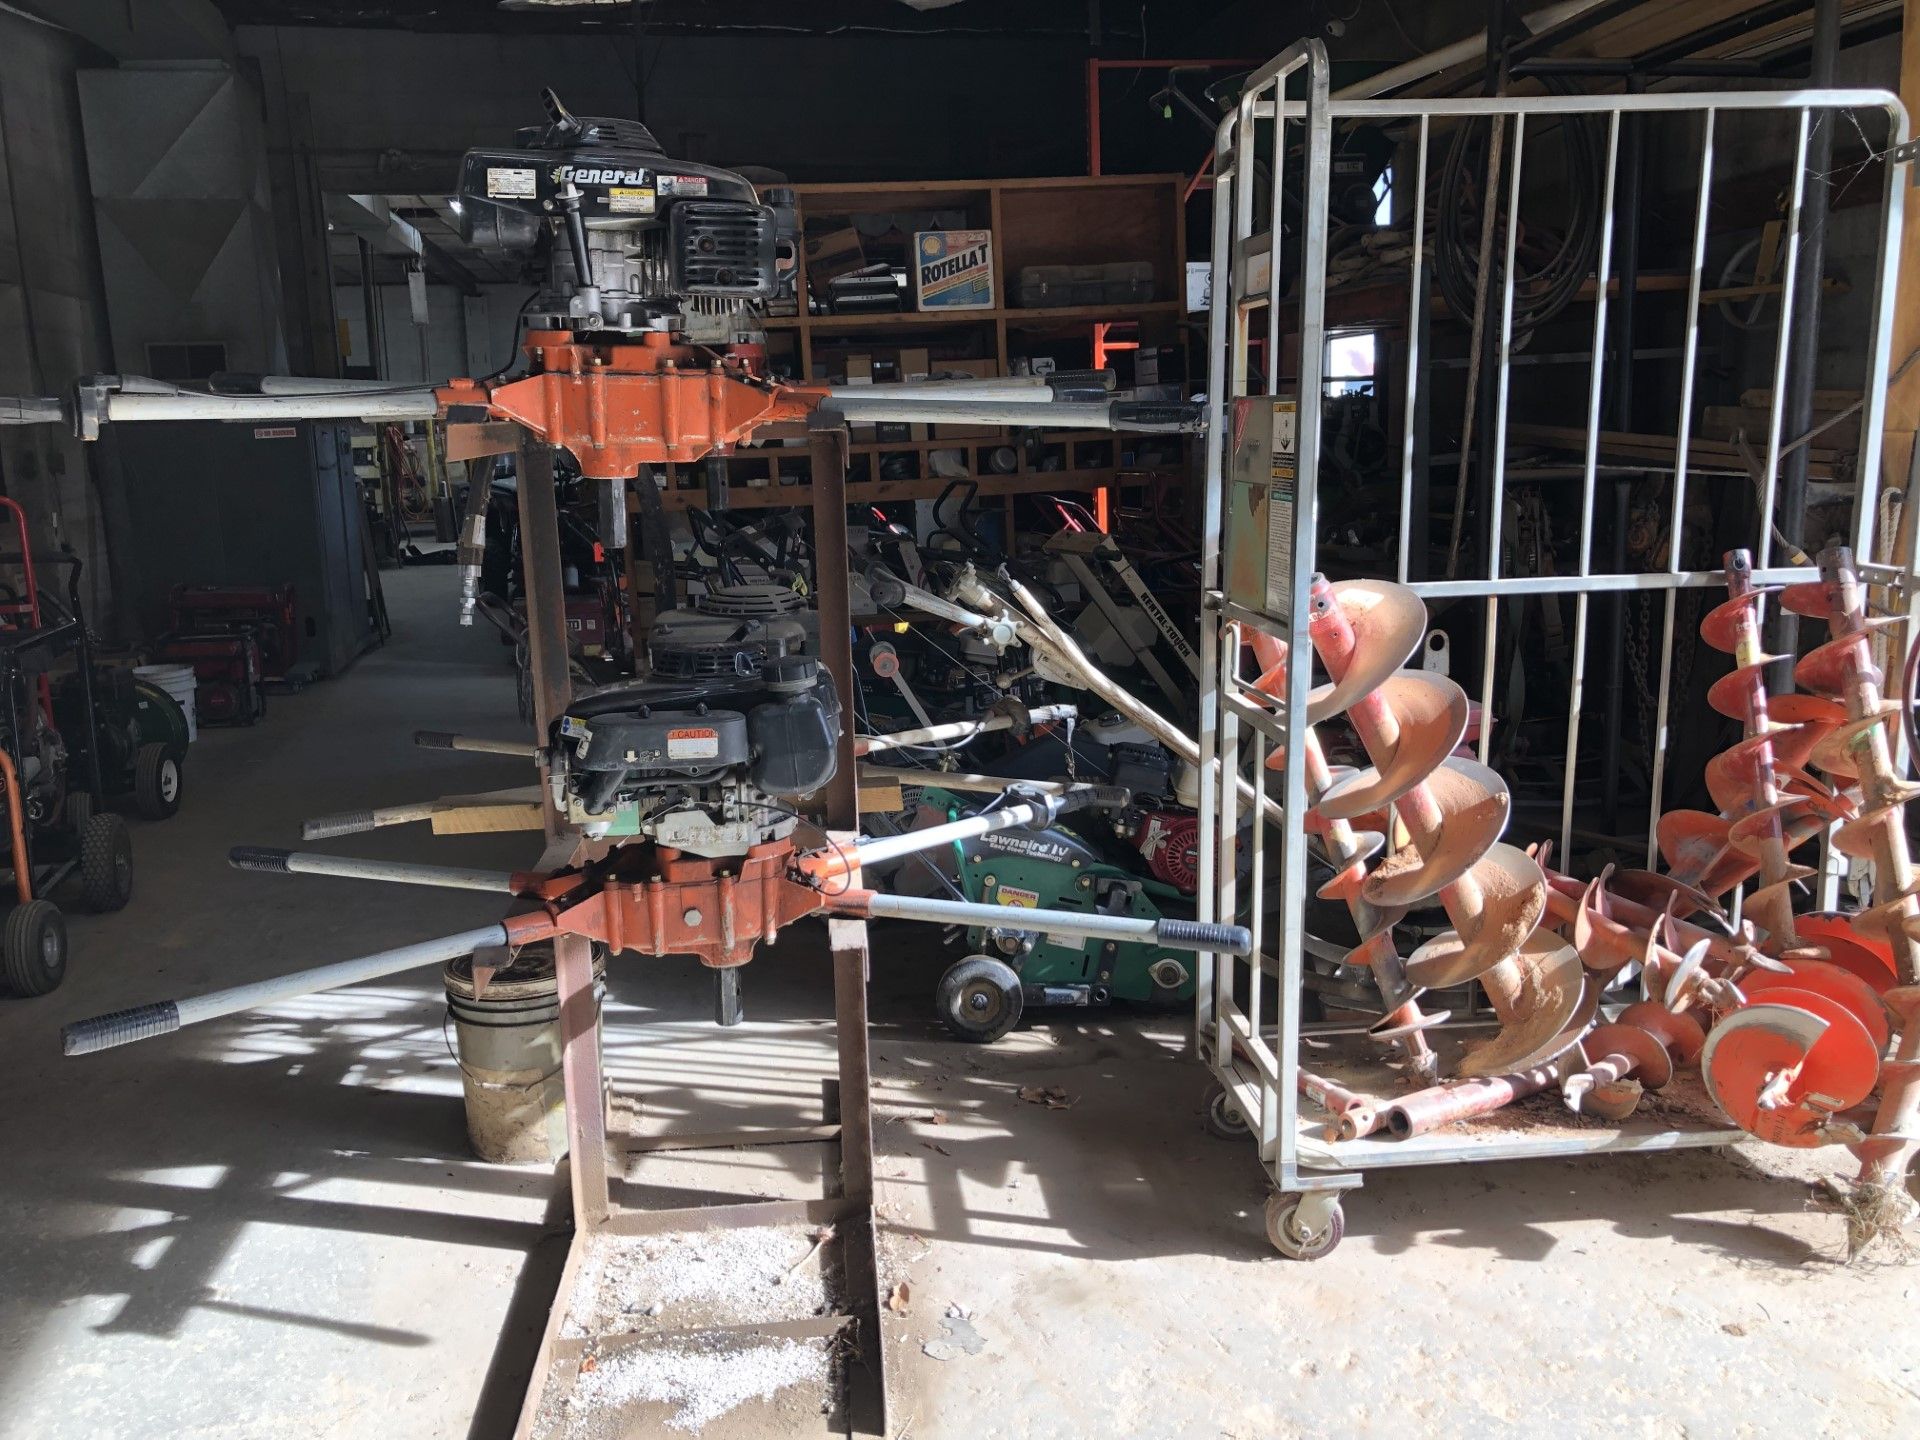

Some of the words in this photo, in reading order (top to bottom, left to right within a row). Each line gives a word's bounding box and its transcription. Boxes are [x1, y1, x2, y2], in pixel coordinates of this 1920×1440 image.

[560, 165, 645, 186] General
[921, 250, 979, 287] ROTELLA
[978, 243, 988, 264] T
[1140, 592, 1191, 657] RENTAL-TOUGH
[980, 832, 1048, 853] Lawnaire
[1051, 843, 1069, 856] IV
[1001, 888, 1037, 900] DANGER
